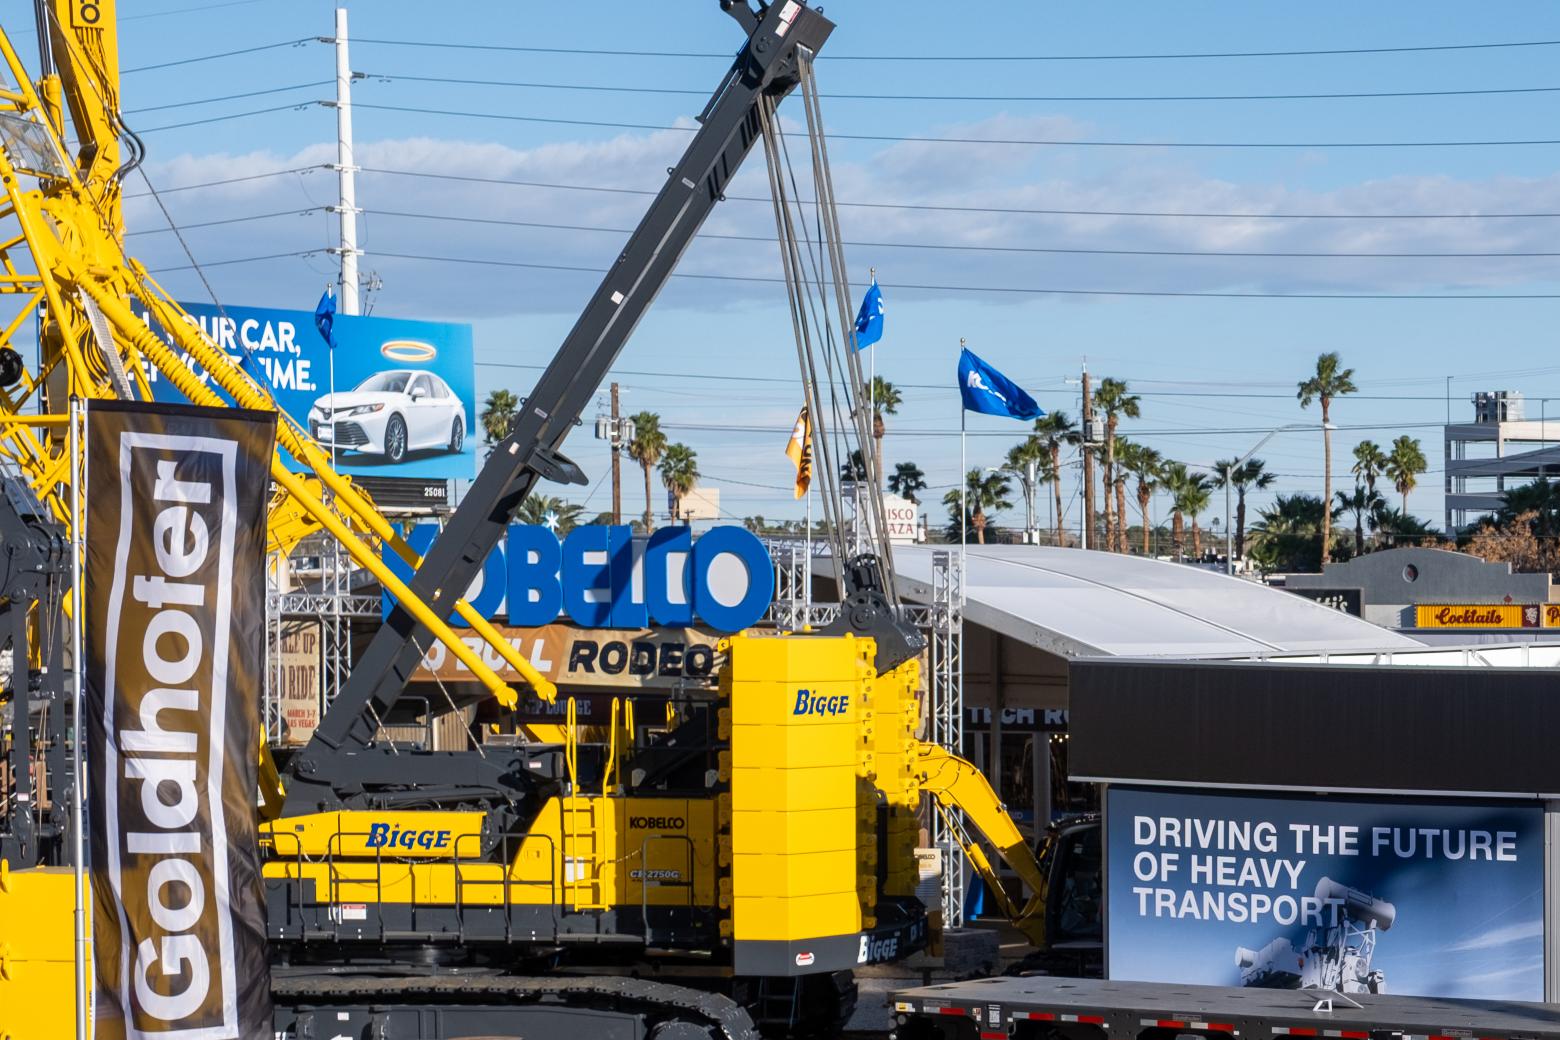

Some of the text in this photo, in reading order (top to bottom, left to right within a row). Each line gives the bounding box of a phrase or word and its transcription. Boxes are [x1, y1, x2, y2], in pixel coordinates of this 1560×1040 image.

[240, 318, 301, 357] CAR,
[1435, 607, 1504, 626] Cocktails
[302, 632, 316, 654] UP
[567, 640, 714, 677] RODEO
[288, 664, 316, 700] RIDE
[545, 699, 592, 717] LOUGE
[121, 460, 213, 1023] Goldhofer
[366, 822, 452, 851] BIGGE
[629, 816, 685, 830] KOBELCO
[1133, 815, 1518, 863] DRIVING THE FUTURE
[1133, 850, 1306, 888] OF HEAVY
[1132, 886, 1347, 927] TRANSPORT
